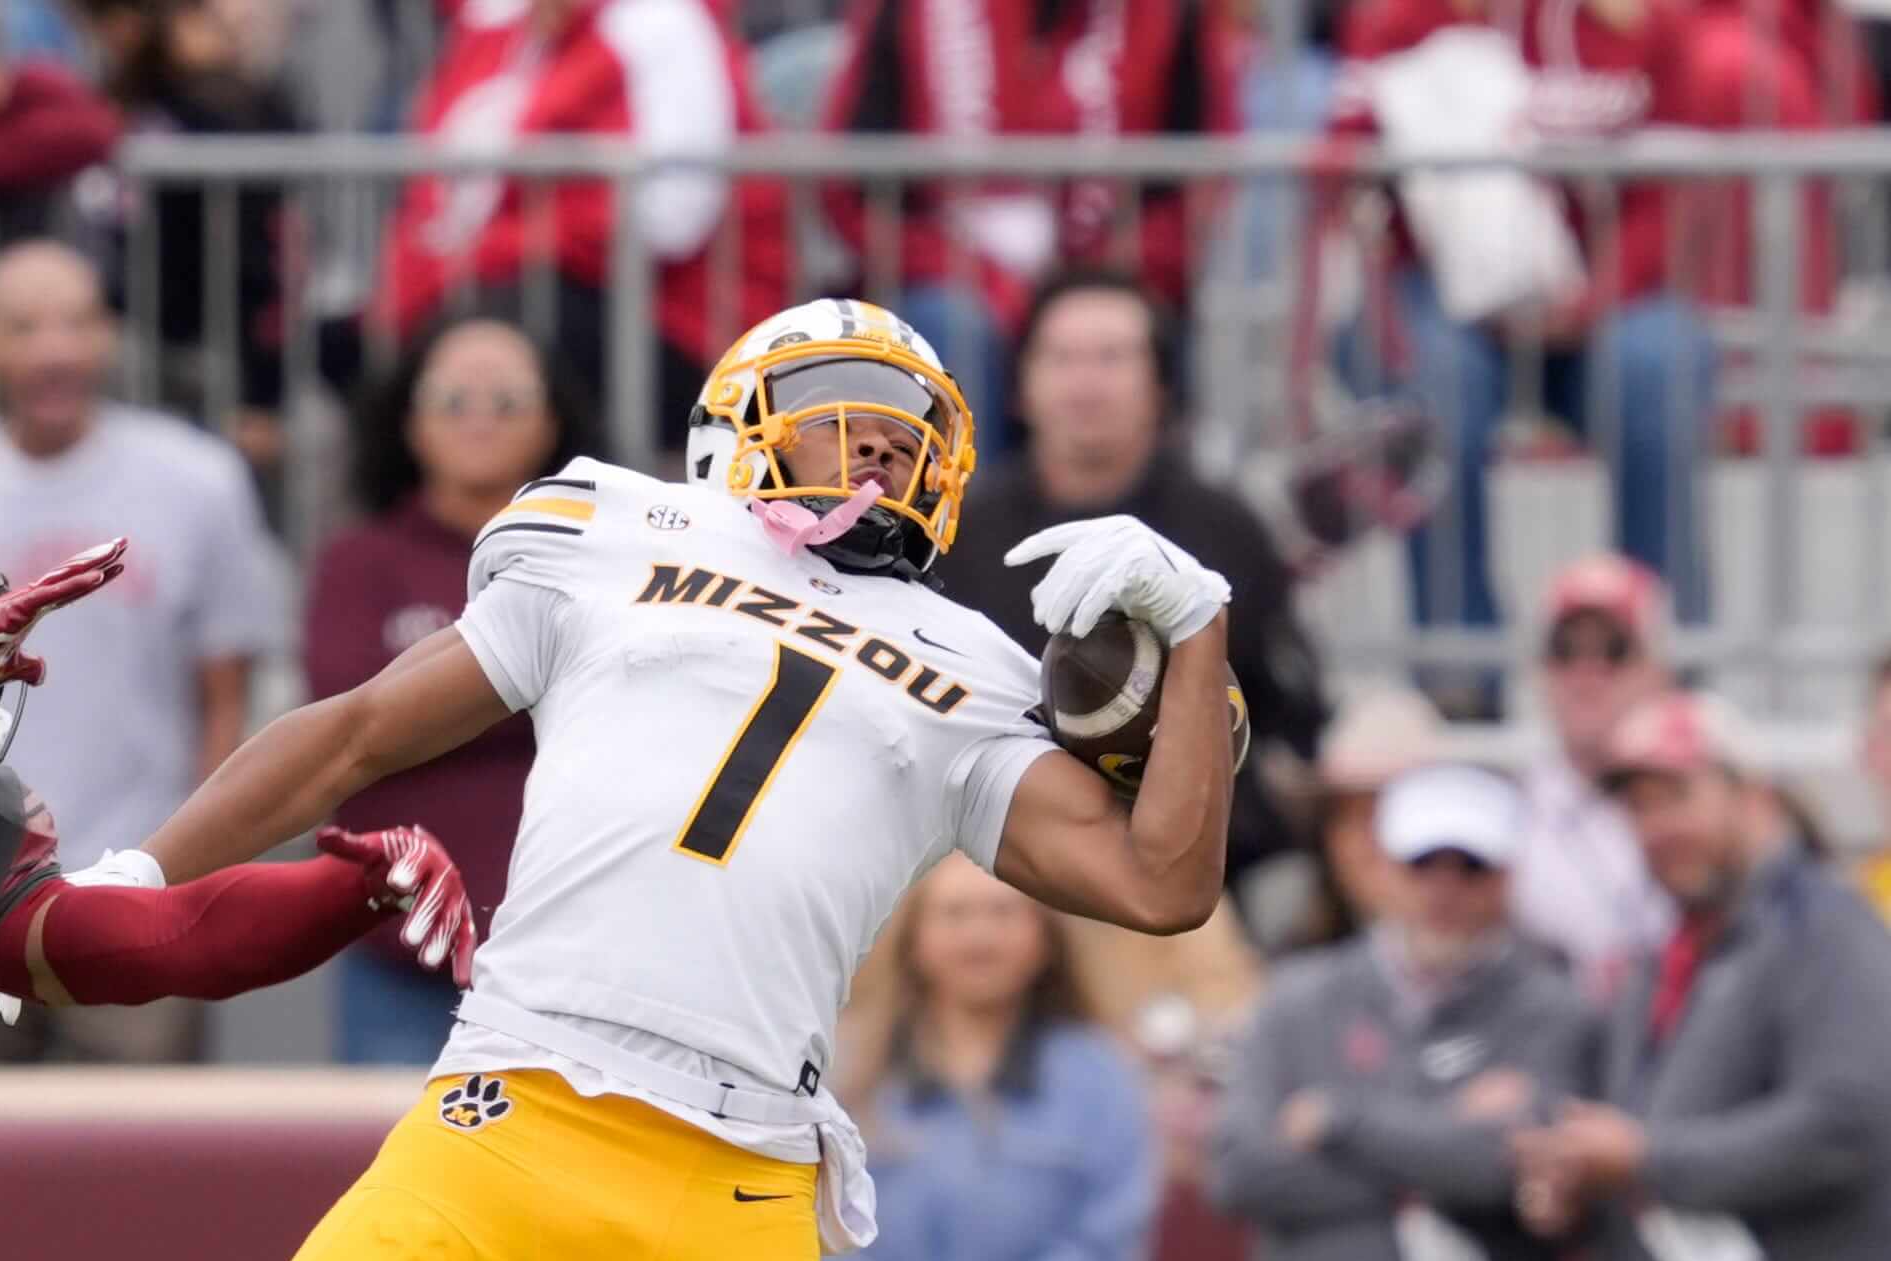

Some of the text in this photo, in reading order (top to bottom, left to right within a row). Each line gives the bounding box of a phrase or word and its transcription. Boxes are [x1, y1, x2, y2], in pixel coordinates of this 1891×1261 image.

[649, 505, 689, 528] SEC
[631, 561, 972, 719] MIZZOU
[670, 638, 843, 869] 1
[445, 1105, 478, 1127] M
